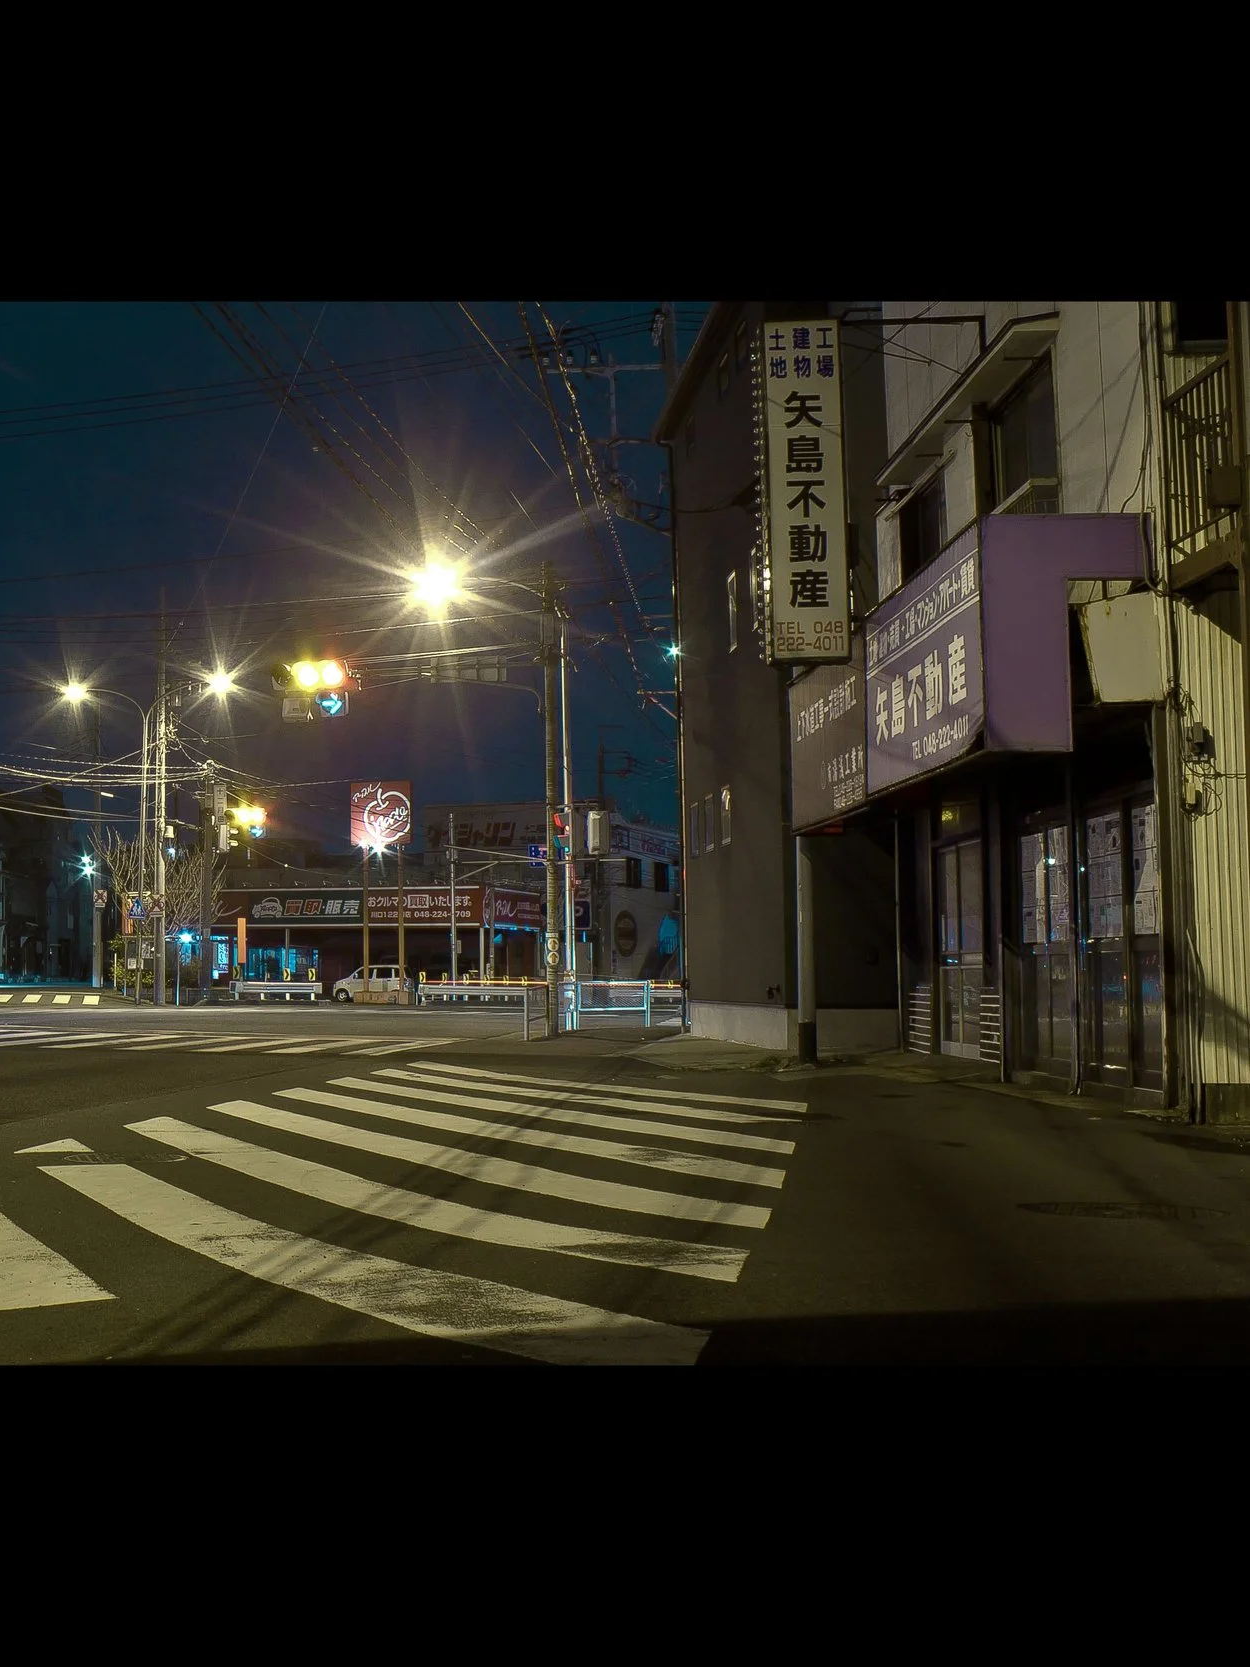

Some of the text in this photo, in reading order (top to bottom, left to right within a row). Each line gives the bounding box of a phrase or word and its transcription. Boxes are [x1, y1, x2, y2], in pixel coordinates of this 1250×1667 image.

[784, 390, 829, 608] 矢島不動産
[776, 621, 844, 635] TEL 048
[776, 636, 845, 652] 222-4011
[876, 634, 967, 746] 矢島不動産
[912, 714, 969, 760] TEL 048-222-4011
[414, 910, 471, 918] 048-224-709
